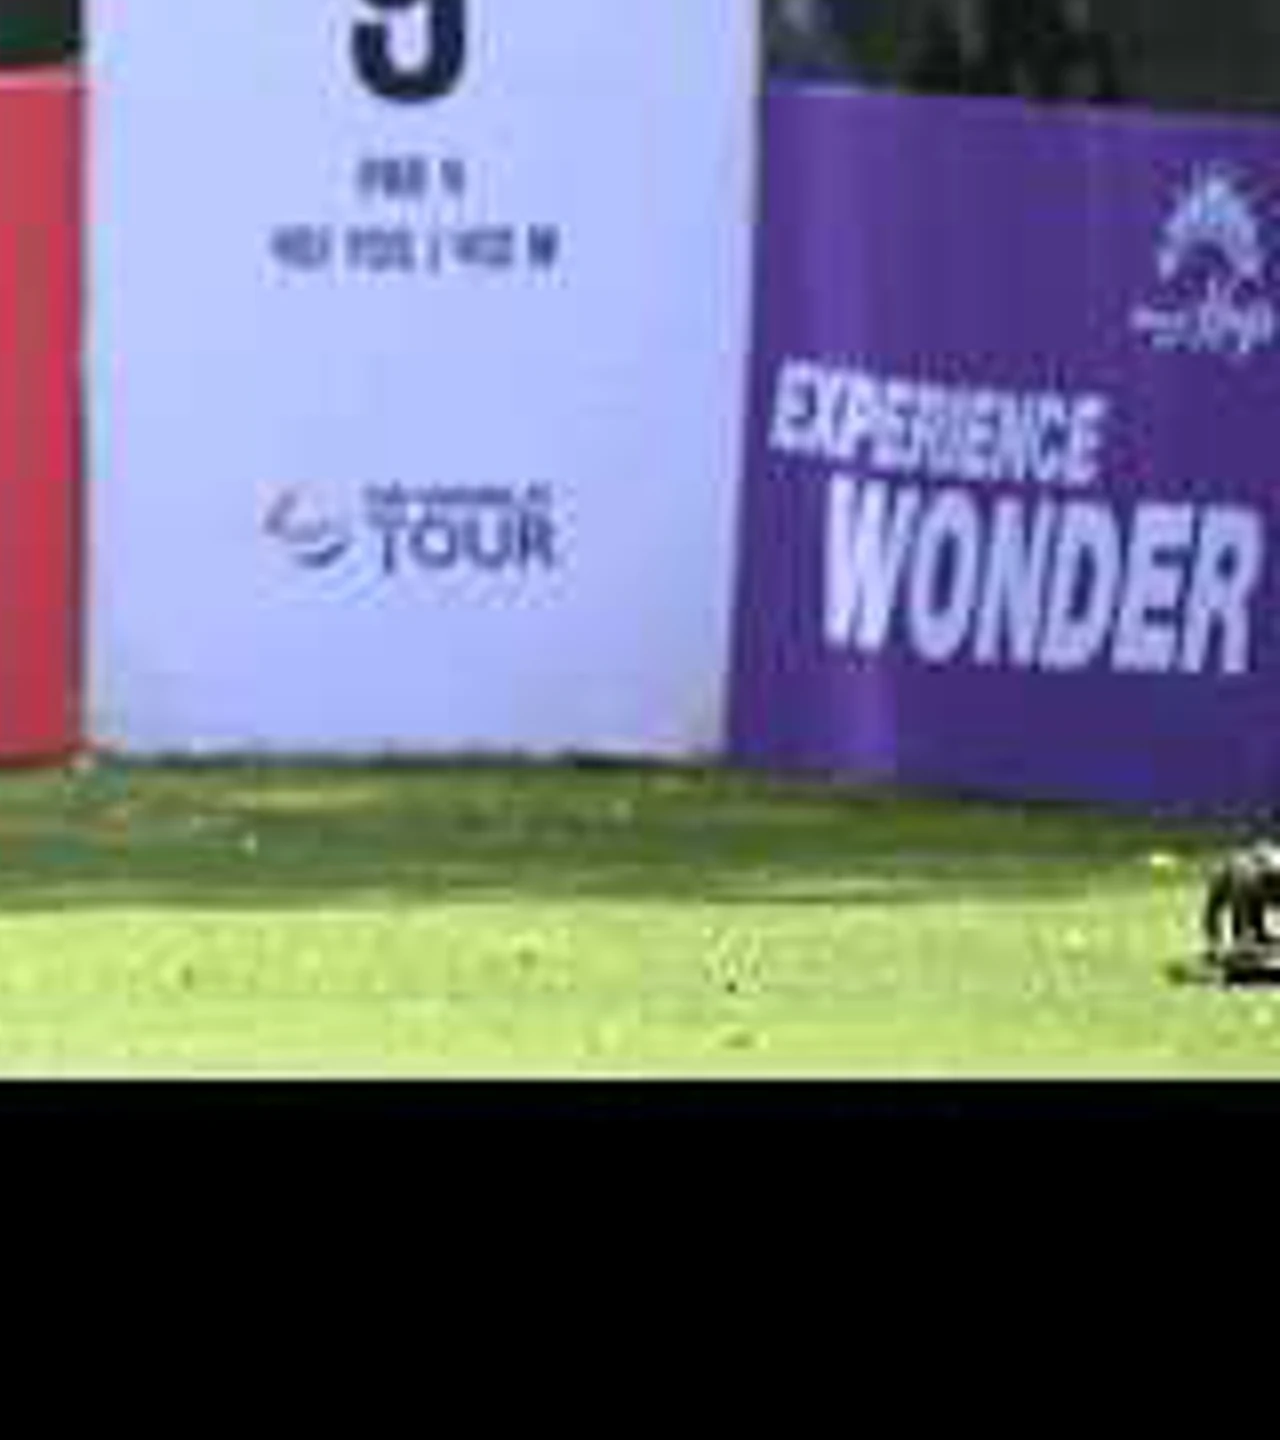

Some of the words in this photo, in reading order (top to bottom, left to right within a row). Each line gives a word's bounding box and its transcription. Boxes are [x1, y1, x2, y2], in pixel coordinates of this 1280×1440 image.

[768, 359, 1110, 488] EXPERIENCE
[361, 508, 554, 575] TOUR
[822, 471, 1264, 674] WONDER
